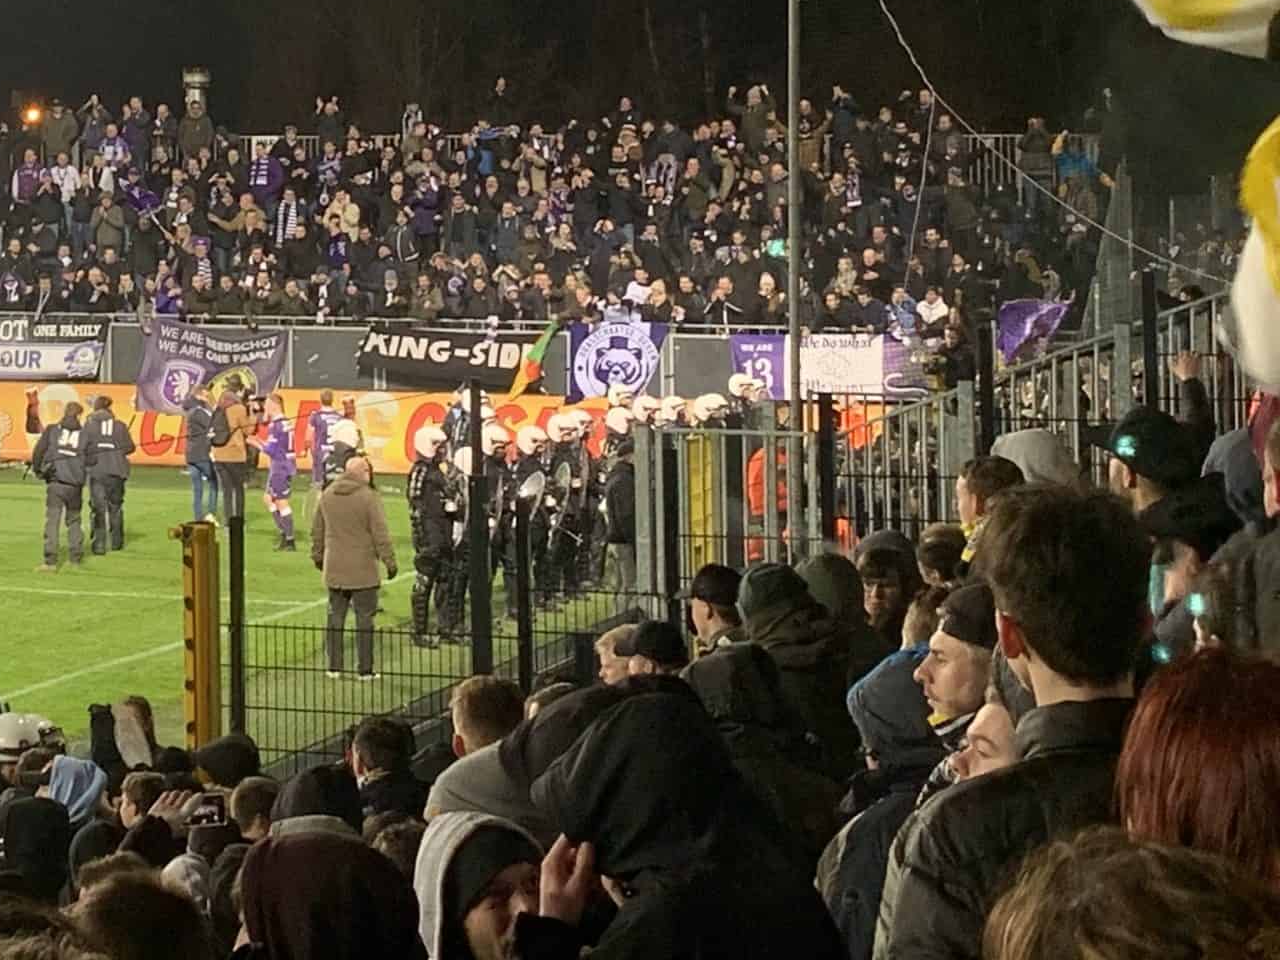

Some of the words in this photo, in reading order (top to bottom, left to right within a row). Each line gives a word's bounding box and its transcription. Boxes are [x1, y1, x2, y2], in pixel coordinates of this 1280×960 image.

[33, 324, 57, 337] ONE
[60, 324, 102, 337] FAMILY
[161, 325, 180, 339] WE
[181, 330, 205, 345] ARE
[159, 339, 178, 353] WE
[180, 345, 204, 359] ARE
